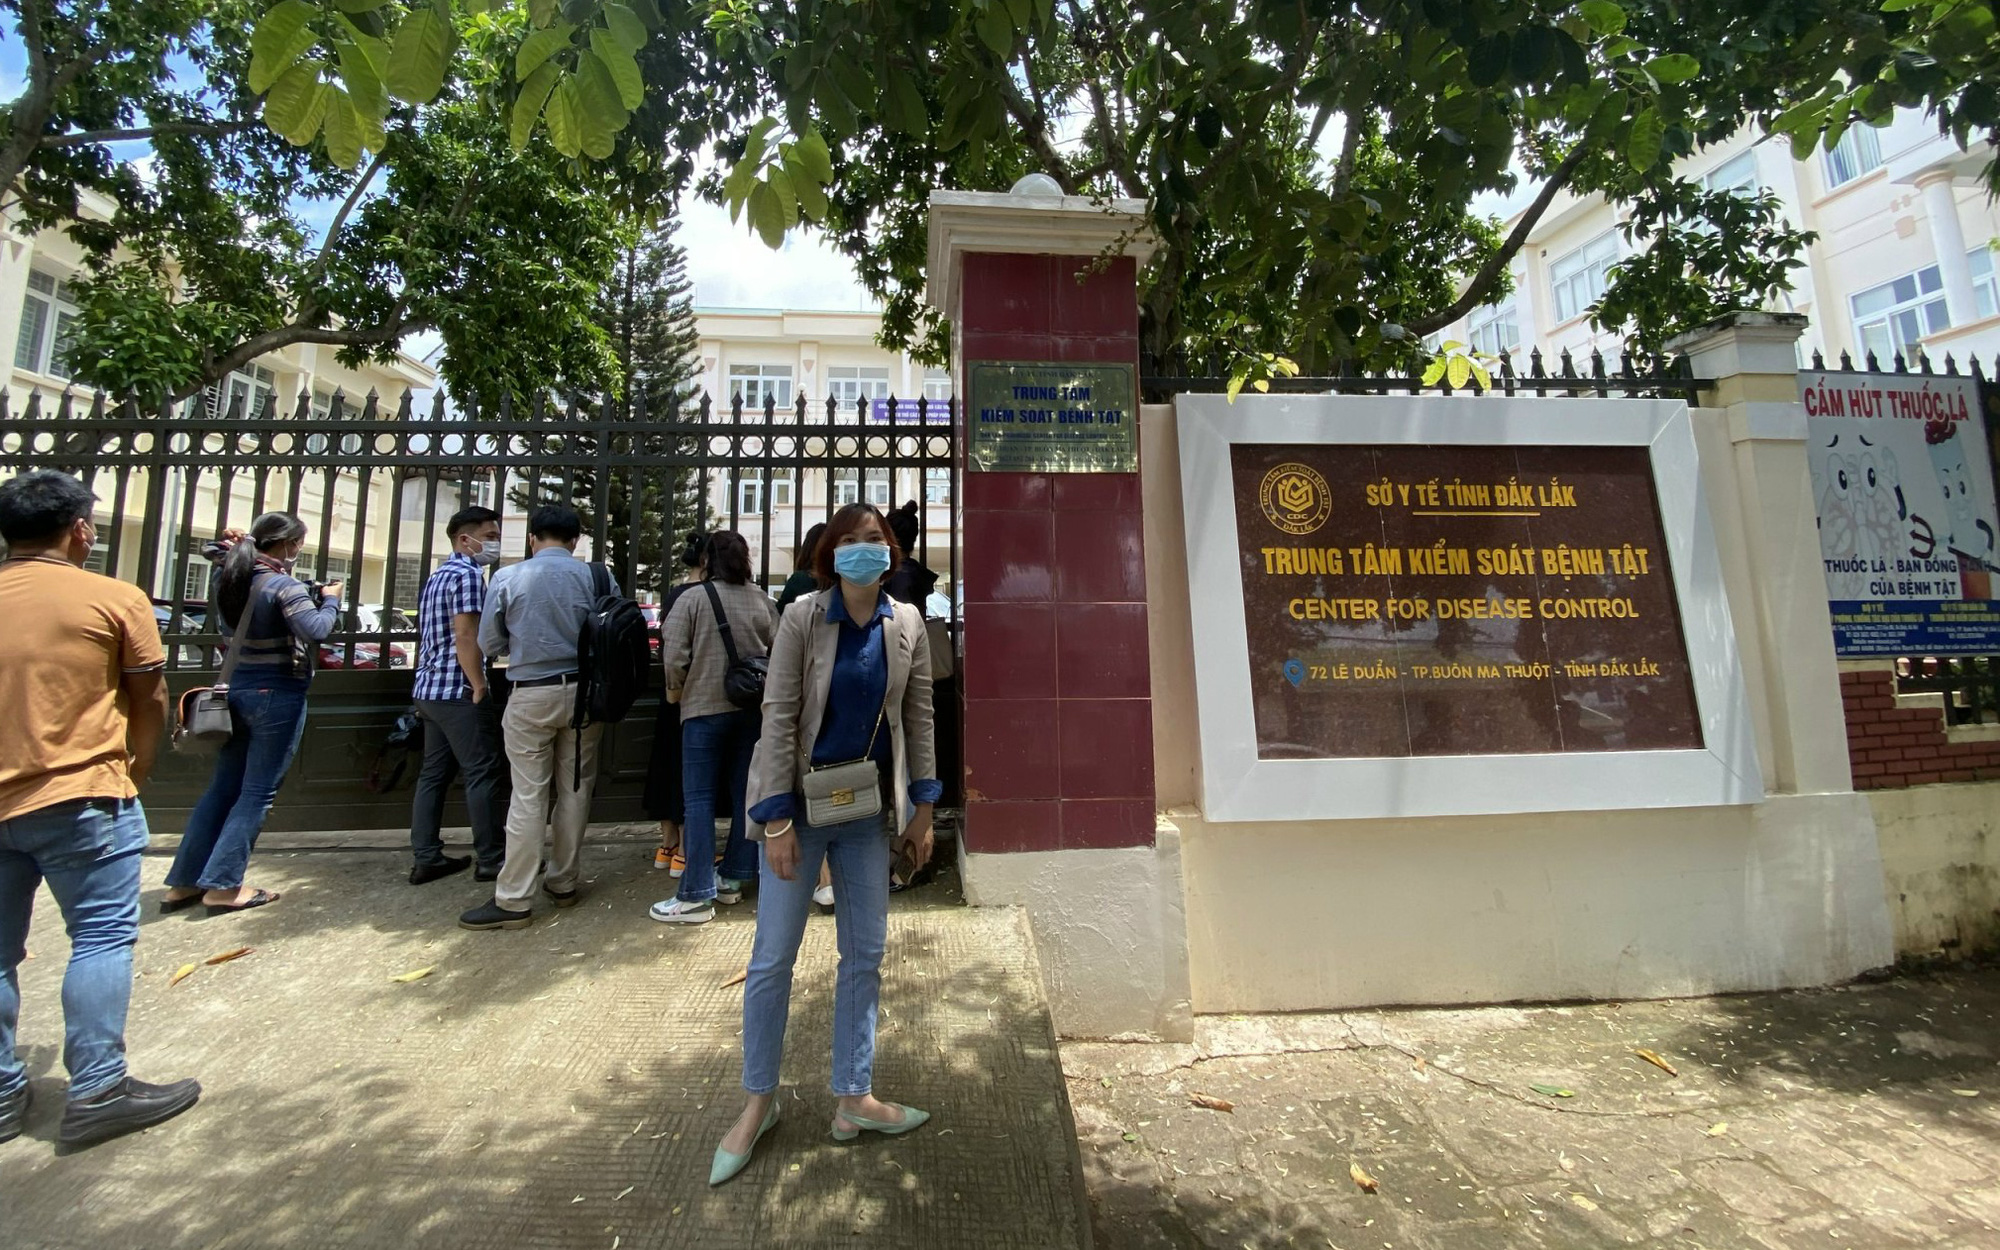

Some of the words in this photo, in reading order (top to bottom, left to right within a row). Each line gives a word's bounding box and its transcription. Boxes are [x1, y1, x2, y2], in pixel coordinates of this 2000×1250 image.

[1012, 386, 1057, 400] TRUNG
[1804, 376, 1845, 417] CẤM
[1848, 382, 1883, 418] HÚT
[1886, 380, 1945, 421] THUỐC
[1947, 386, 1970, 421] LÁ
[1366, 476, 1393, 506] SỞ
[1398, 484, 1410, 506] Y
[1415, 477, 1440, 506] TẾ
[1444, 478, 1491, 506] TỈNH
[1495, 476, 1535, 507] ĐẮK
[1539, 476, 1577, 507] LẮK
[1261, 547, 1344, 575] TRUNG
[1349, 543, 1402, 575] TÂM
[1408, 538, 1470, 575] KIỂM
[1476, 543, 1536, 575] SOÁT
[1541, 543, 1605, 581] BỆNH
[1609, 543, 1649, 581] TẬT
[1824, 554, 1868, 573] THUỐC
[1871, 556, 1887, 573] LÁ
[1897, 560, 1921, 577] BẠN
[1870, 577, 1895, 596] CỦA
[1899, 578, 1931, 599] BỆNH
[1935, 578, 1957, 599] TẬT
[1289, 598, 1380, 620] CENTER
[1386, 598, 1430, 619] FOR
[1437, 598, 1533, 619] DISEASE
[1539, 597, 1639, 619] CONTROL
[1310, 666, 1328, 679] 72
[1332, 663, 1349, 680] LÊ
[1354, 659, 1398, 680] DUẨN
[1477, 665, 1500, 679] MA
[1504, 662, 1550, 680] THUỘT
[1564, 660, 1596, 678] TỈNH
[1600, 657, 1630, 677] ĐẮK
[1633, 657, 1660, 676] LẮK
